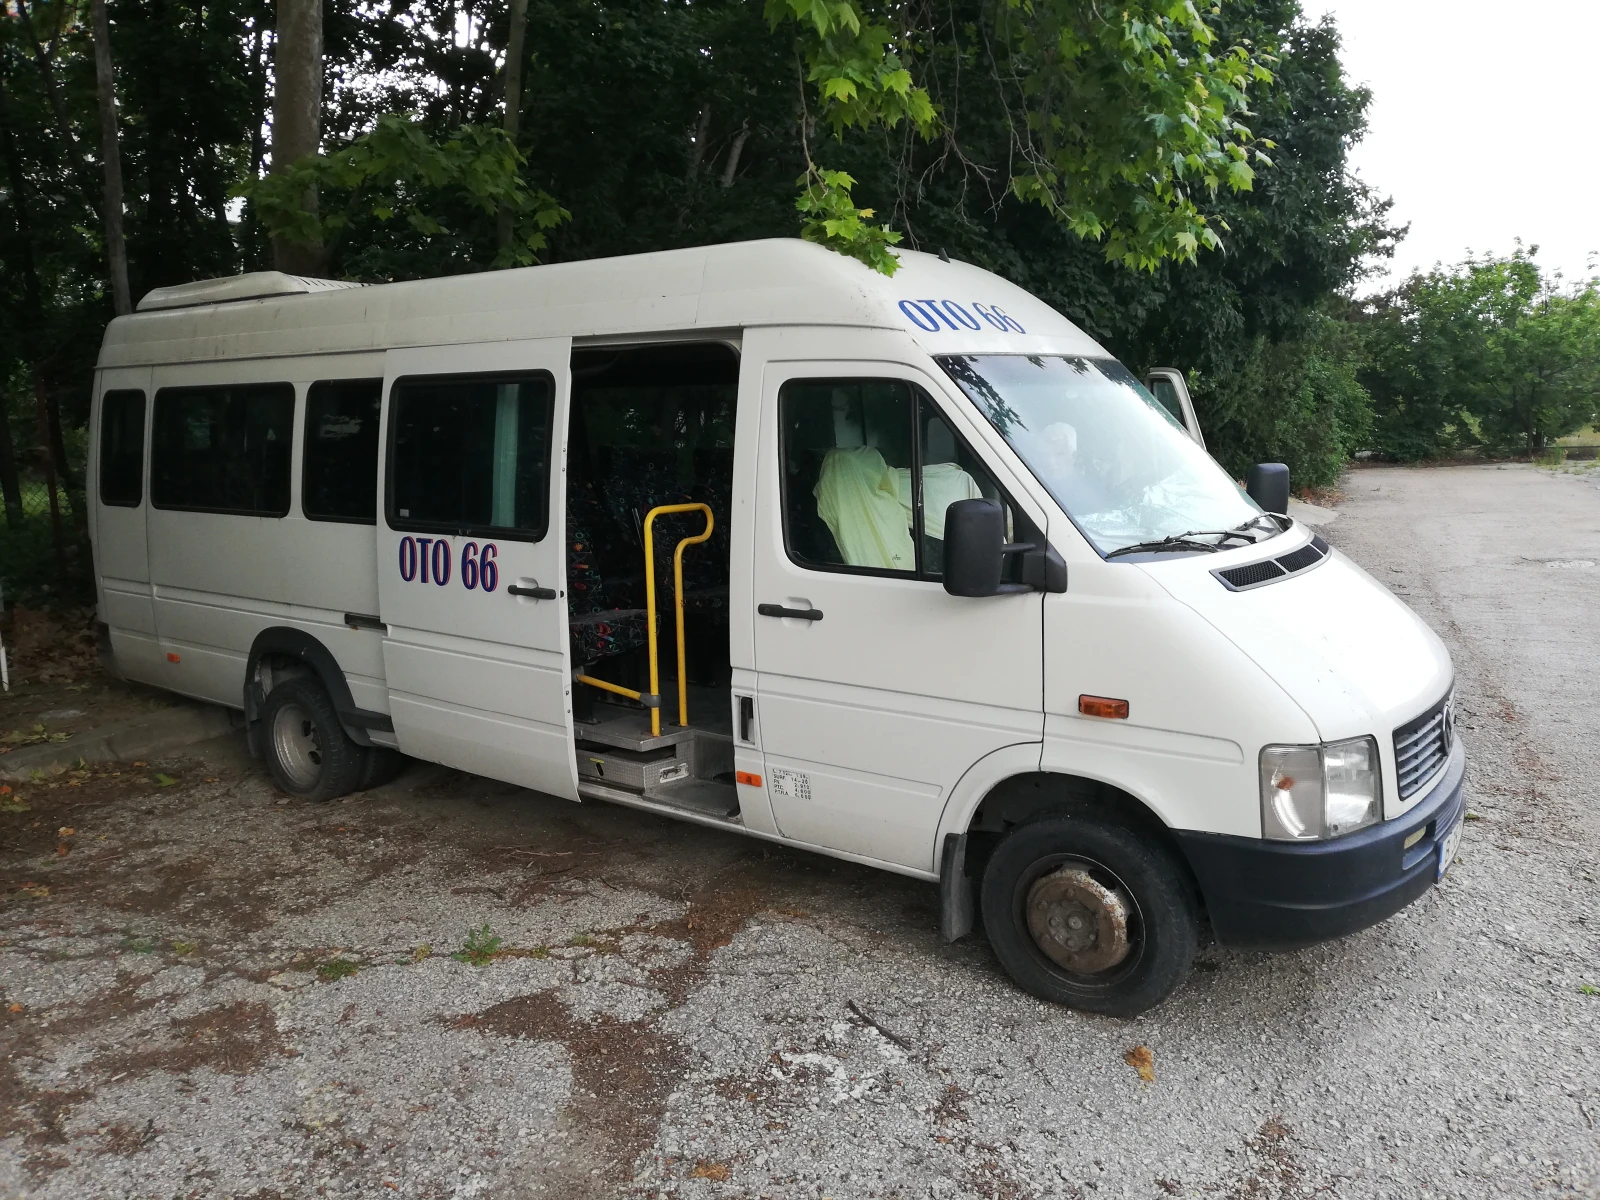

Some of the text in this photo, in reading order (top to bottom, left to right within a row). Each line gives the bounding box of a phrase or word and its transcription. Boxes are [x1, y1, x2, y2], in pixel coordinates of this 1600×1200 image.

[898, 300, 1027, 334] OTO 66
[399, 536, 499, 592] OTO 66
